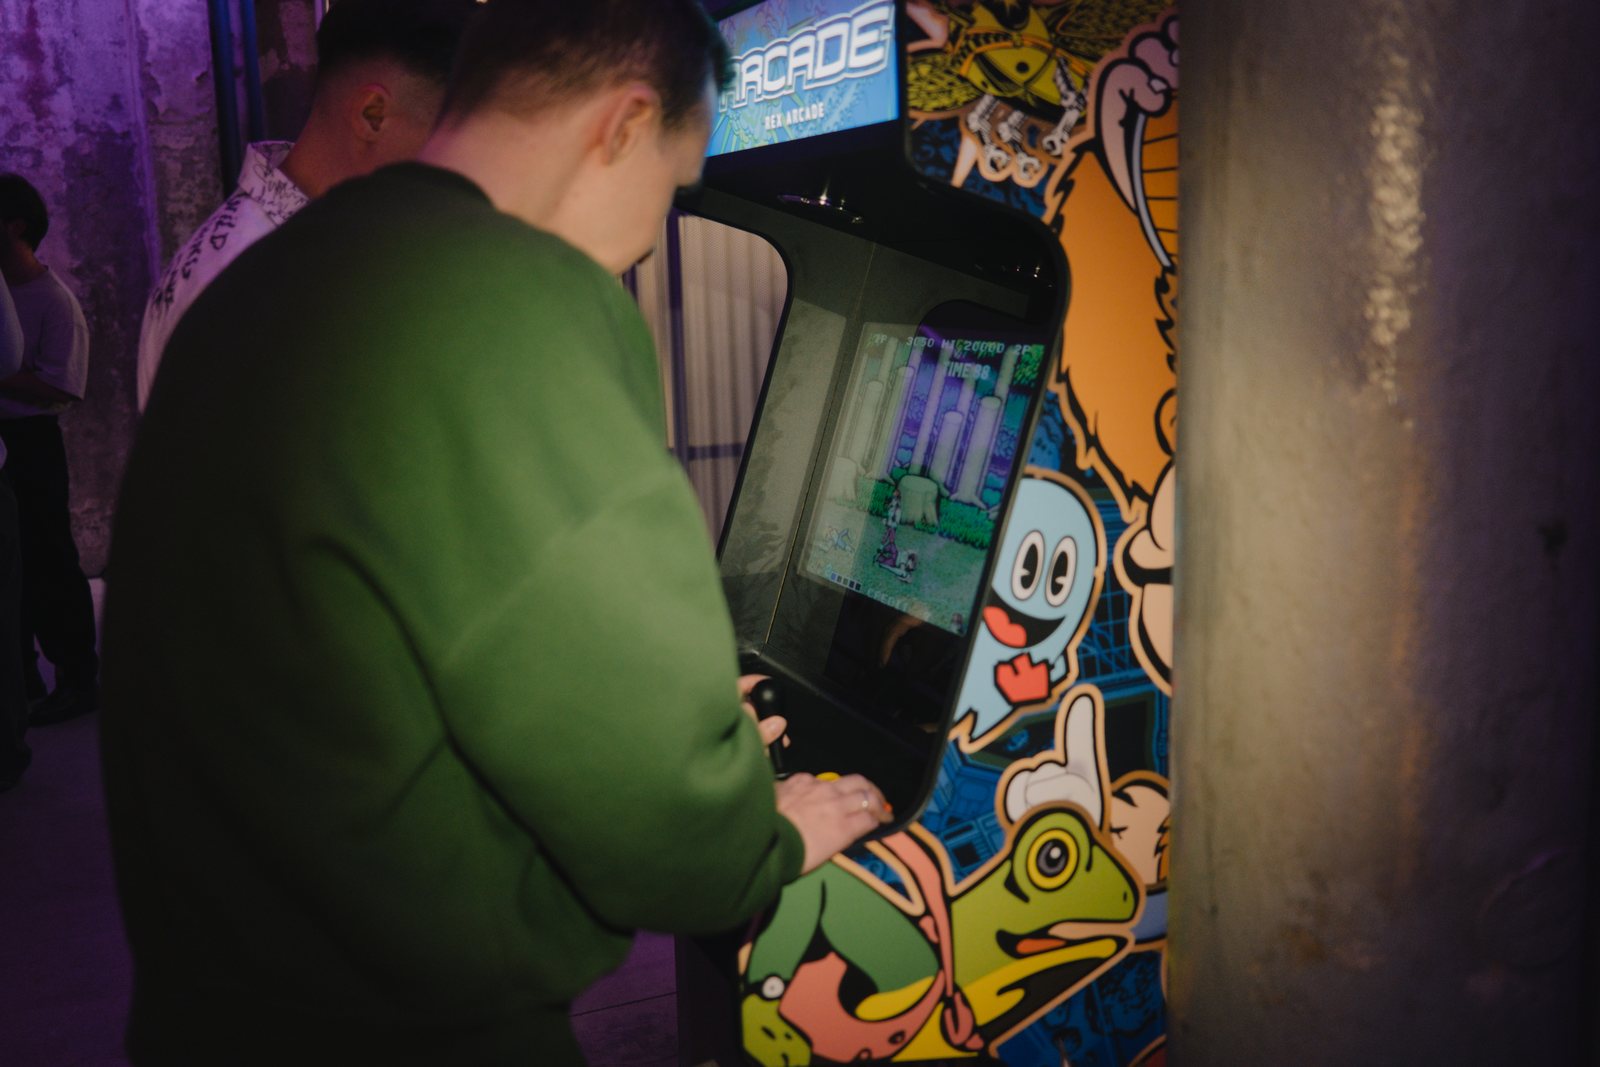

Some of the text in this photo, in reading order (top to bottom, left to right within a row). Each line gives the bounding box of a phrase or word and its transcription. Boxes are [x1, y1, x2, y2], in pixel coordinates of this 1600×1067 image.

[765, 102, 825, 130] REX ARCADE
[964, 340, 1006, 353] 20000
[944, 361, 975, 378] TIME
